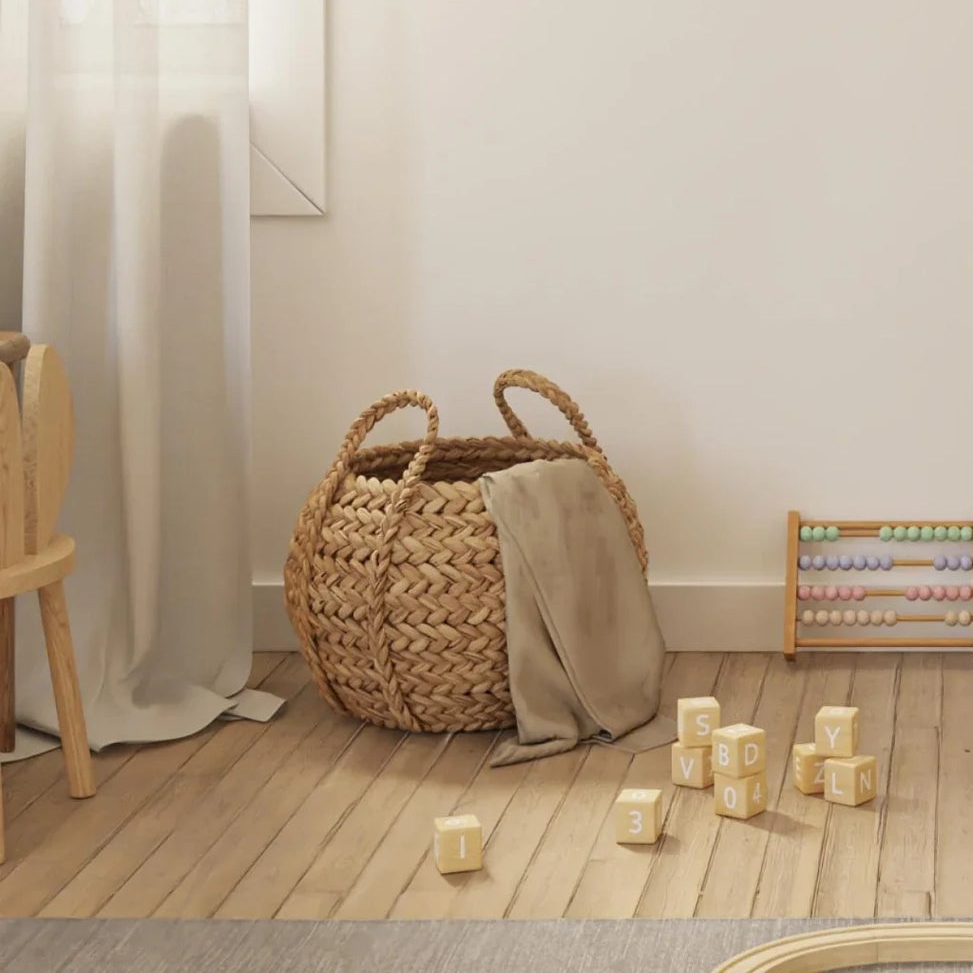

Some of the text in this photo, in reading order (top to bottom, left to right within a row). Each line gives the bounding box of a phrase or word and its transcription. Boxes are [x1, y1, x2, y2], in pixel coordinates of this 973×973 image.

[696, 714, 710, 736] S
[824, 725, 841, 749] Y
[718, 743, 730, 766] B
[745, 743, 759, 766] D
[680, 756, 695, 780] V
[832, 771, 844, 795] L
[860, 768, 872, 794] N
[628, 810, 643, 834] 3
